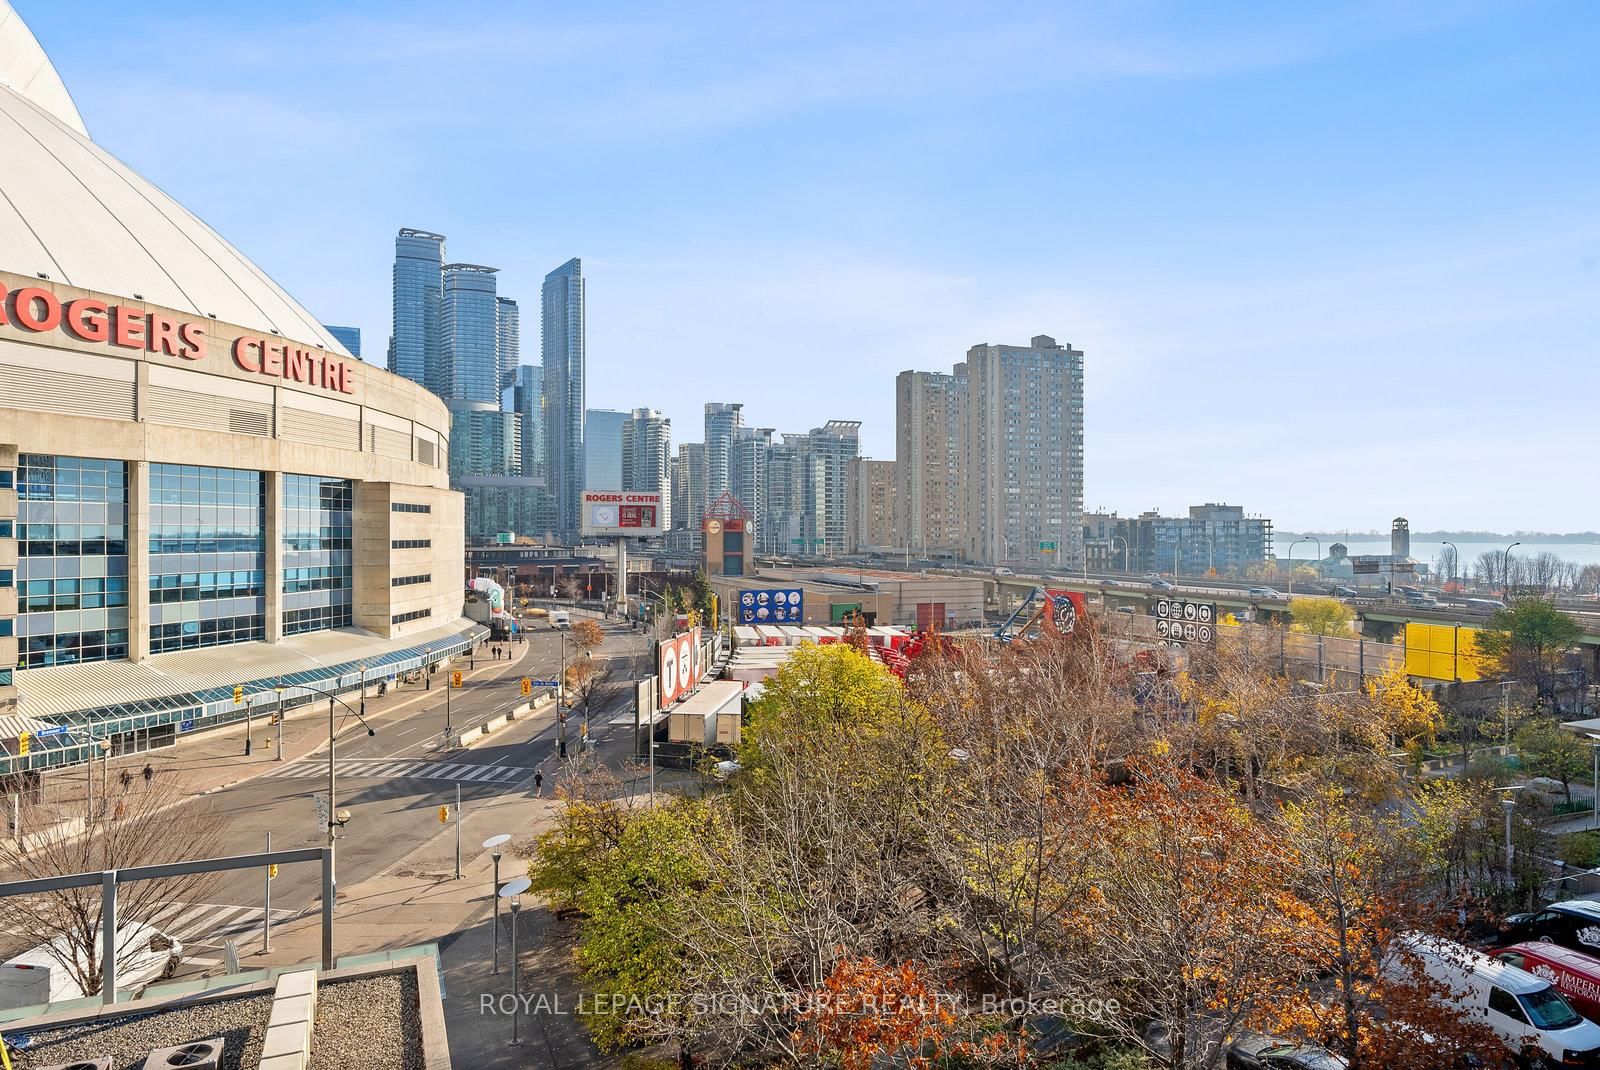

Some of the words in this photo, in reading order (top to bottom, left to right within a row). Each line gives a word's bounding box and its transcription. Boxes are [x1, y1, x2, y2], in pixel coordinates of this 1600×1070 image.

[0, 281, 208, 360] OGERS
[233, 335, 356, 395] CENTRE
[586, 494, 623, 502] ROGERS
